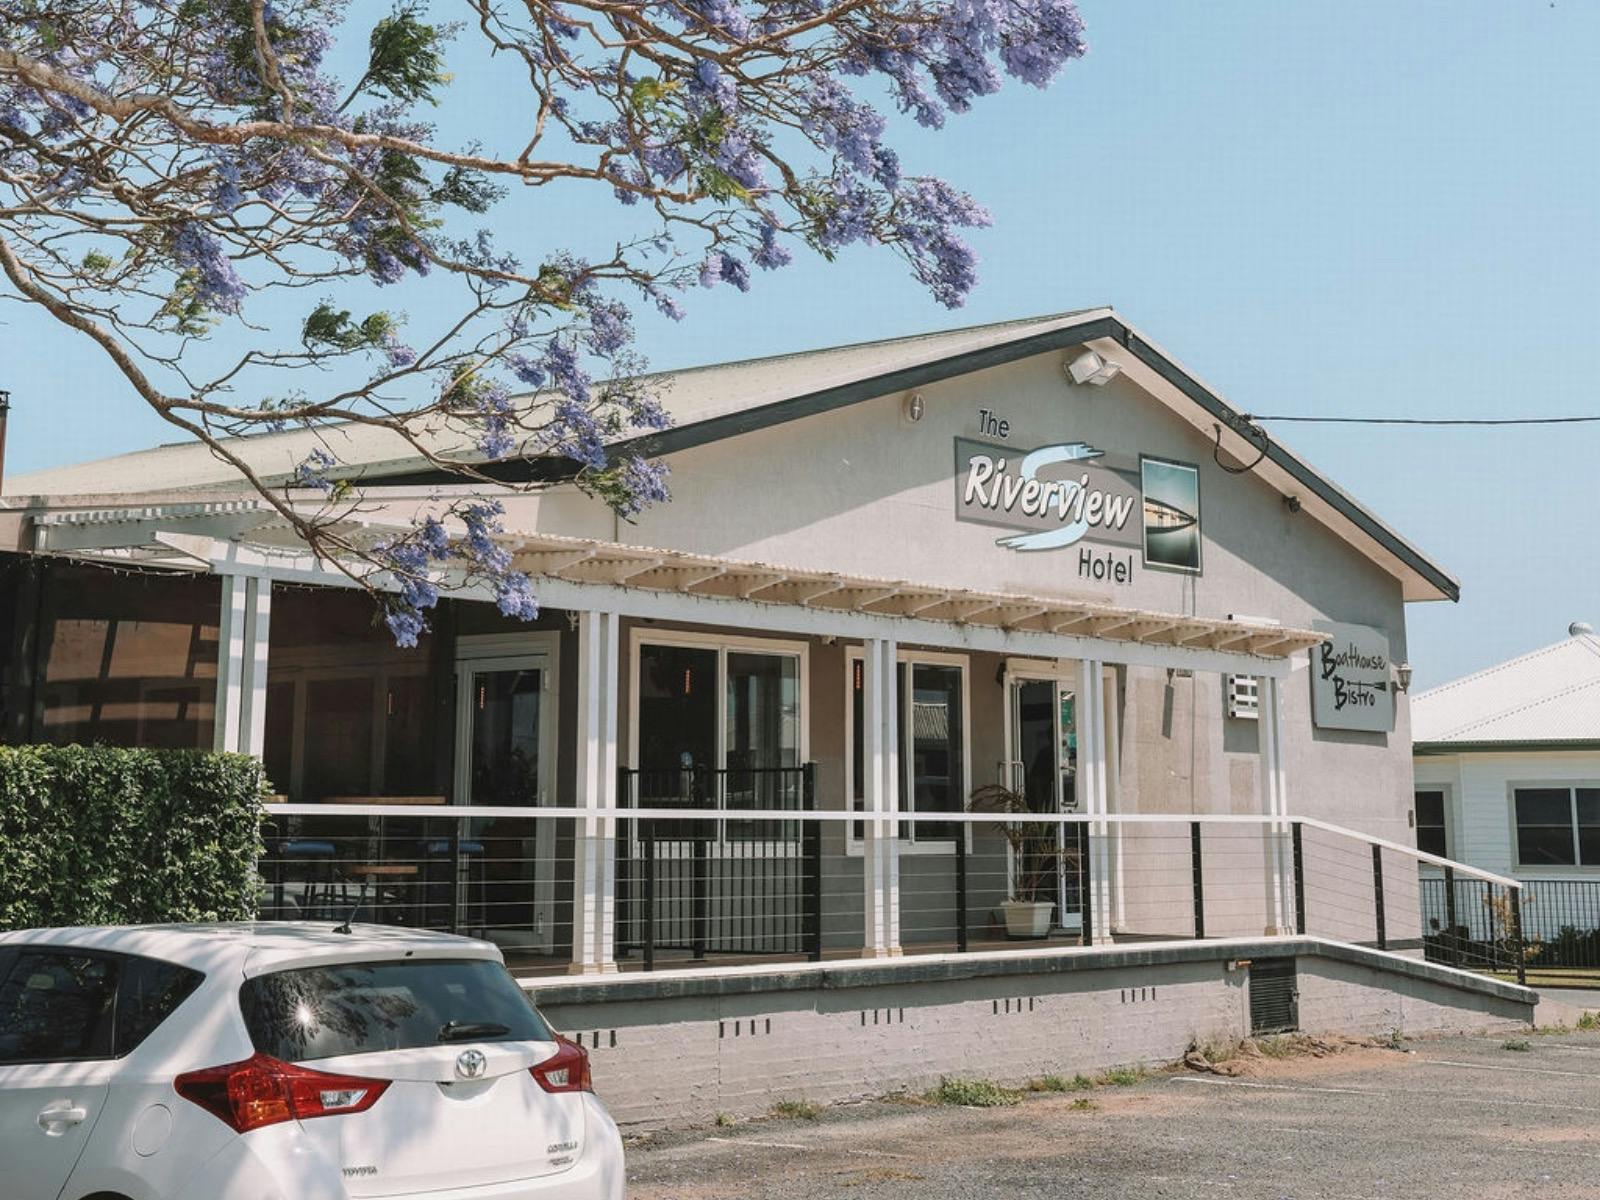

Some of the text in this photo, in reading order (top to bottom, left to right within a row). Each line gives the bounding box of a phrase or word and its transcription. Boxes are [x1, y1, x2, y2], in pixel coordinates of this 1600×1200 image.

[979, 409, 1010, 438] The
[964, 454, 1134, 530] Riverview
[1078, 547, 1133, 584] Hotel
[1320, 640, 1387, 680] Boathouse
[1332, 674, 1376, 711] Bistro
[342, 1165, 377, 1177] TOYOTA
